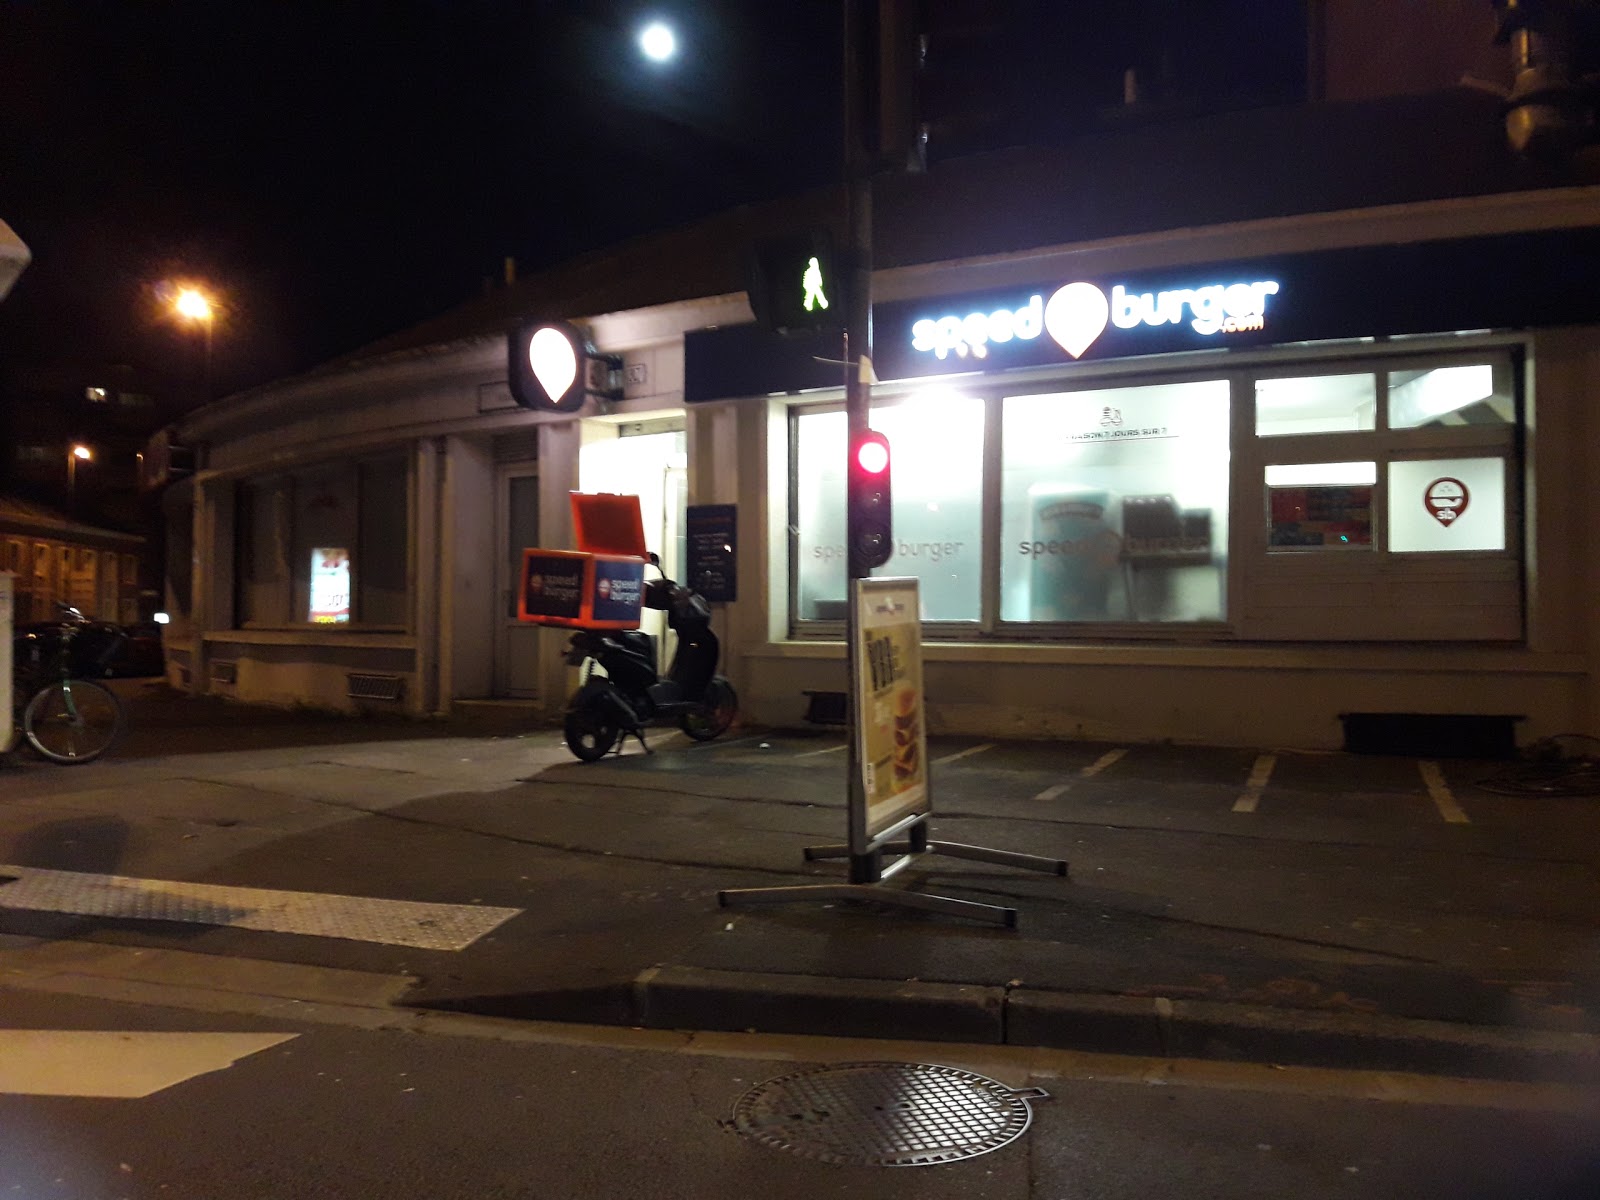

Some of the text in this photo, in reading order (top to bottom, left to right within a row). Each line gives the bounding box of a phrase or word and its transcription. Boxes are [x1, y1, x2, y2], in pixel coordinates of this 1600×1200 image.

[912, 281, 1280, 360] speed burger
[1436, 507, 1457, 520] sb
[814, 538, 964, 563] spe burger
[611, 577, 640, 591] speed
